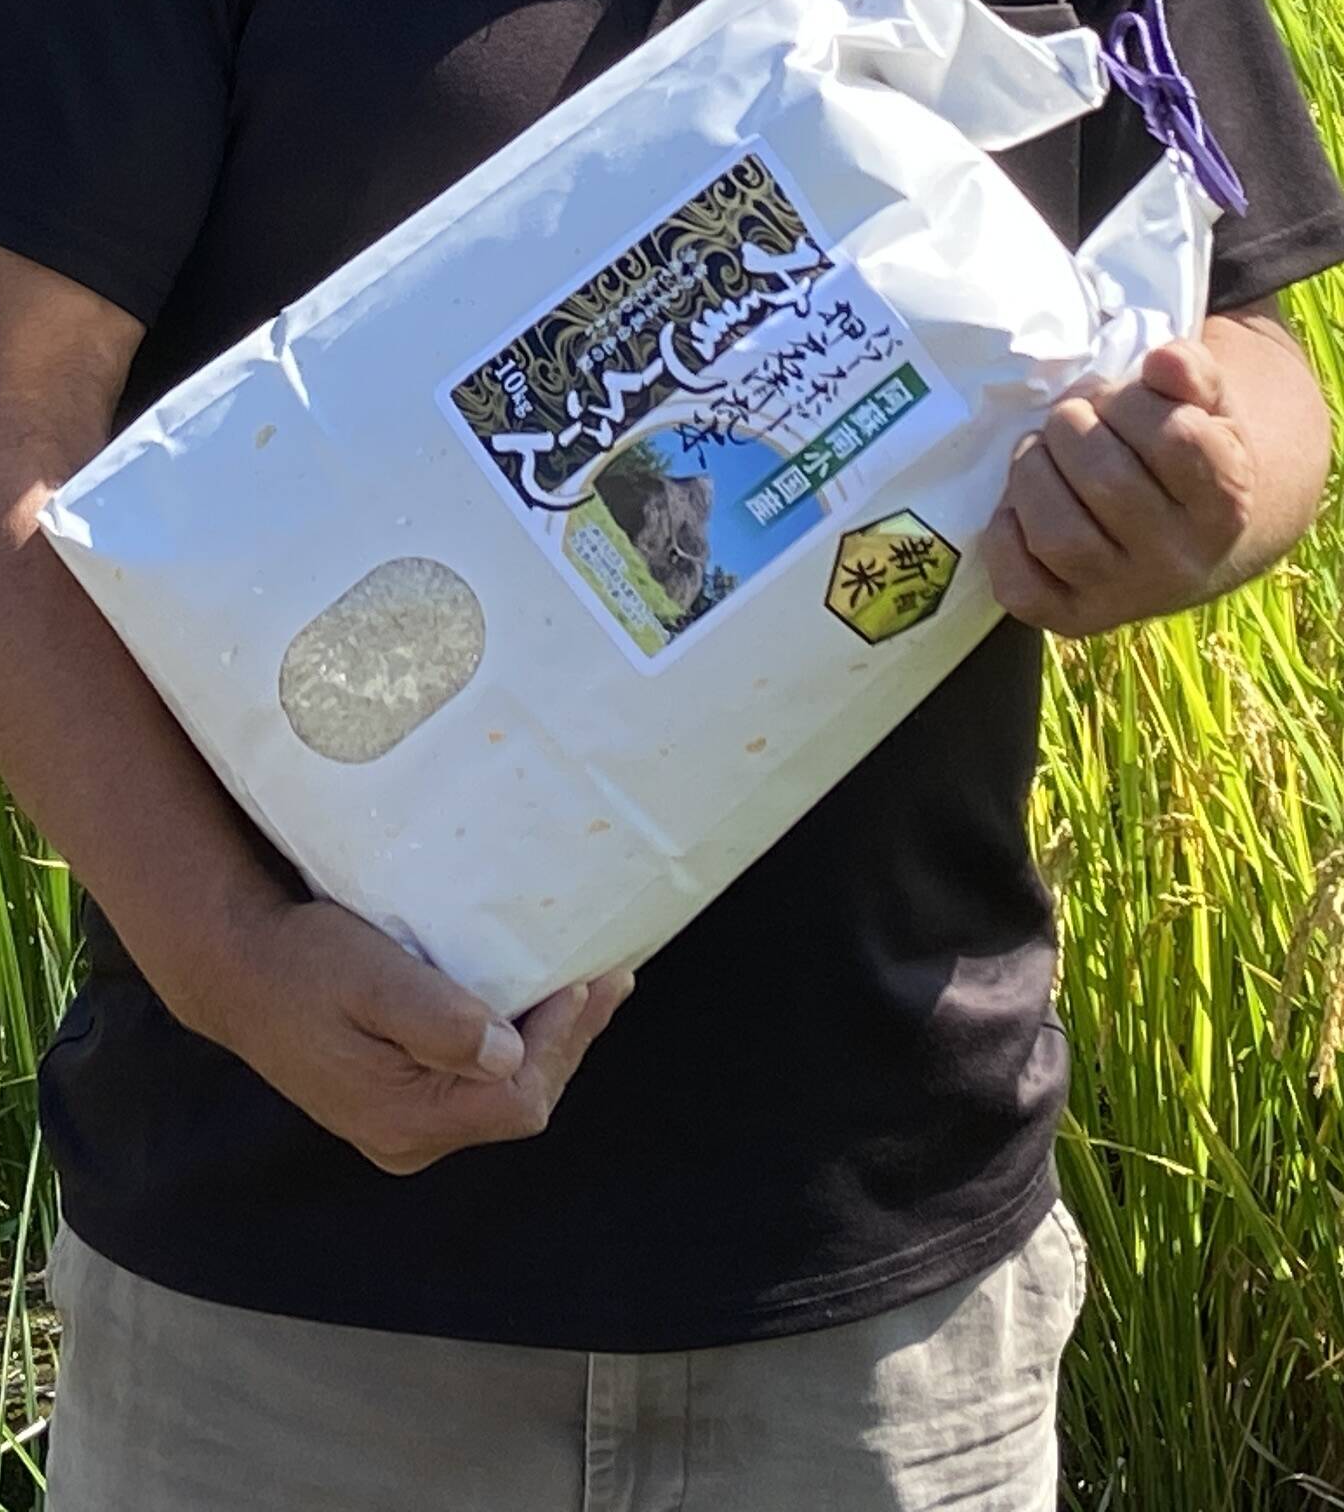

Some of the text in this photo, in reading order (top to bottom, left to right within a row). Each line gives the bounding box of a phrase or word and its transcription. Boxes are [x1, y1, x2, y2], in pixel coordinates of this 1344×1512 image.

[492, 357, 533, 419] 10kg
[767, 324, 902, 431] パワースポット
[744, 376, 913, 526] 阿蘇南小国産
[841, 539, 938, 608] 新米
